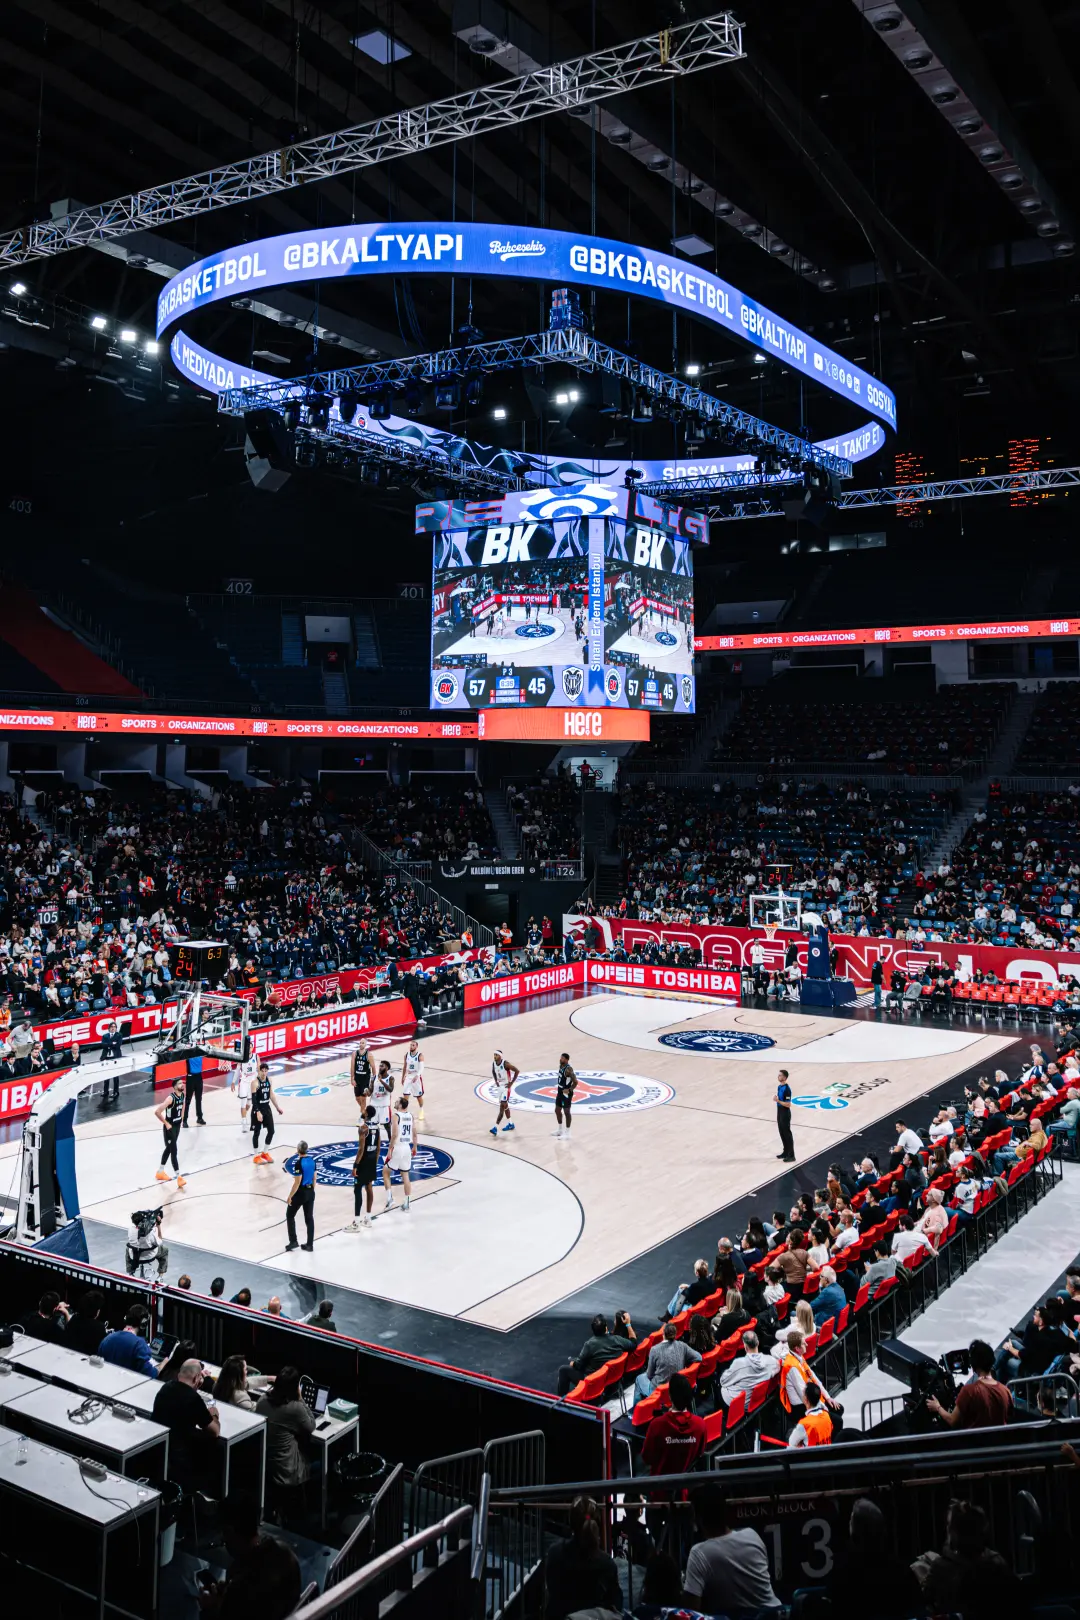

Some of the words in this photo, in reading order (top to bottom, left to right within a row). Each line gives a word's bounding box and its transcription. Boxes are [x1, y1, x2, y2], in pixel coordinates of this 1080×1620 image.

[284, 234, 462, 270] @BKALTYAPI
[570, 245, 733, 319] @BKBASKETBOL
[740, 304, 807, 364] @BKALTYAPI
[182, 344, 234, 390] MEDYADA
[867, 384, 894, 419] SOSYAL
[8, 500, 32, 513] 403
[480, 523, 538, 565] BK
[633, 528, 667, 569] BK
[591, 553, 601, 597] Istanbul
[226, 582, 252, 594] 402
[400, 587, 424, 598] 401
[591, 600, 601, 636] Erdem
[753, 636, 782, 645] SPORTS
[793, 633, 856, 643] ORGANIZATIONS
[912, 629, 946, 638] SPORTS
[957, 625, 1029, 636] ORGANIZATIONS
[591, 639, 601, 672] Sinan
[440, 683, 452, 694] BK
[469, 680, 486, 695] 57
[528, 678, 546, 694] 45
[628, 680, 639, 696] 57
[663, 683, 673, 699] 45
[0, 715, 54, 726] NIZATIONS
[121, 718, 156, 729] SPORTS
[168, 720, 235, 731] ORGANIZATIONS
[287, 724, 323, 733] SPORTS
[337, 724, 418, 734] ORGANIZATIONS
[557, 867, 575, 876] 126
[38, 911, 58, 925] 105
[622, 927, 942, 985] DRAGN'S
[176, 960, 193, 977] 24
[524, 967, 574, 991] TOSHIBA
[652, 970, 736, 992] TOSHIBA
[243, 977, 340, 1004] DAGONS
[294, 1011, 369, 1044] TOSHIBA
[262, 1034, 413, 1073] STANBUL
[837, 1077, 891, 1099] EuroCup
[402, 1124, 411, 1136] 34
[736, 1506, 768, 1518] BLOK
[777, 1499, 816, 1514] BLOCK
[764, 1517, 834, 1581] 13
